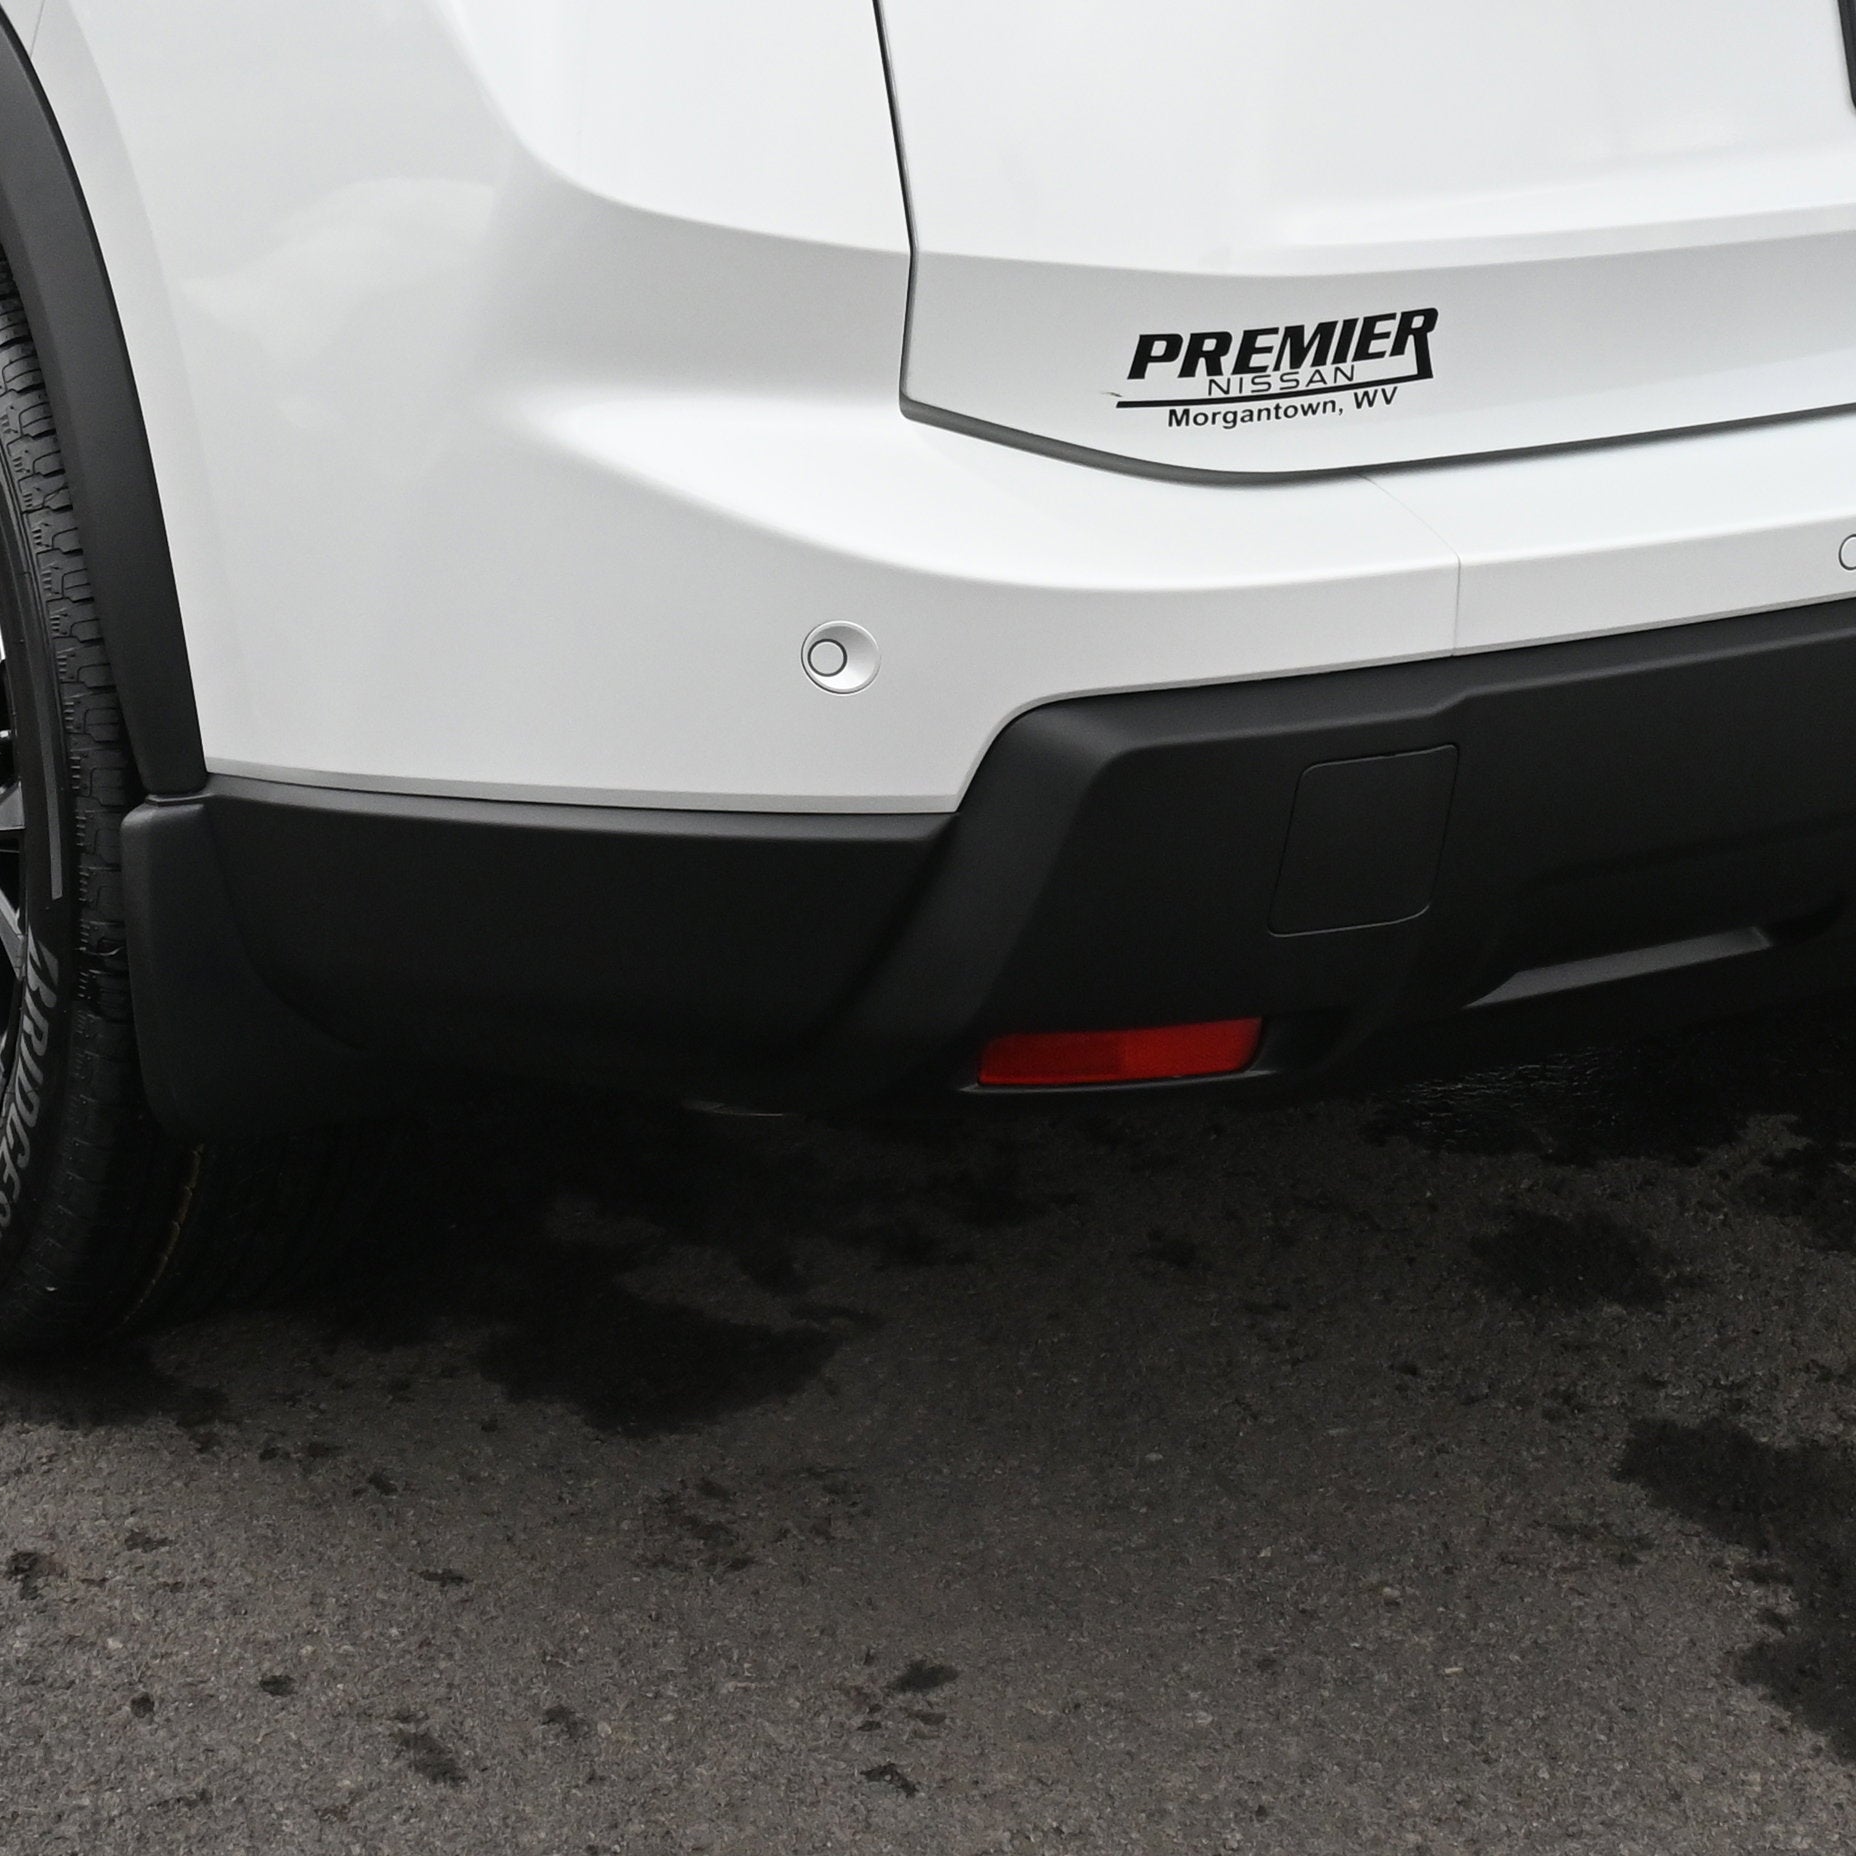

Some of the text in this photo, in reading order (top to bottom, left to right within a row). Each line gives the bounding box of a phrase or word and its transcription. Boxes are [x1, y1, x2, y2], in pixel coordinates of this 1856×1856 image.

[1127, 307, 1439, 380] PREMIER
[1208, 364, 1356, 397] NISSAN
[1168, 386, 1398, 430] Morgantown, WV
